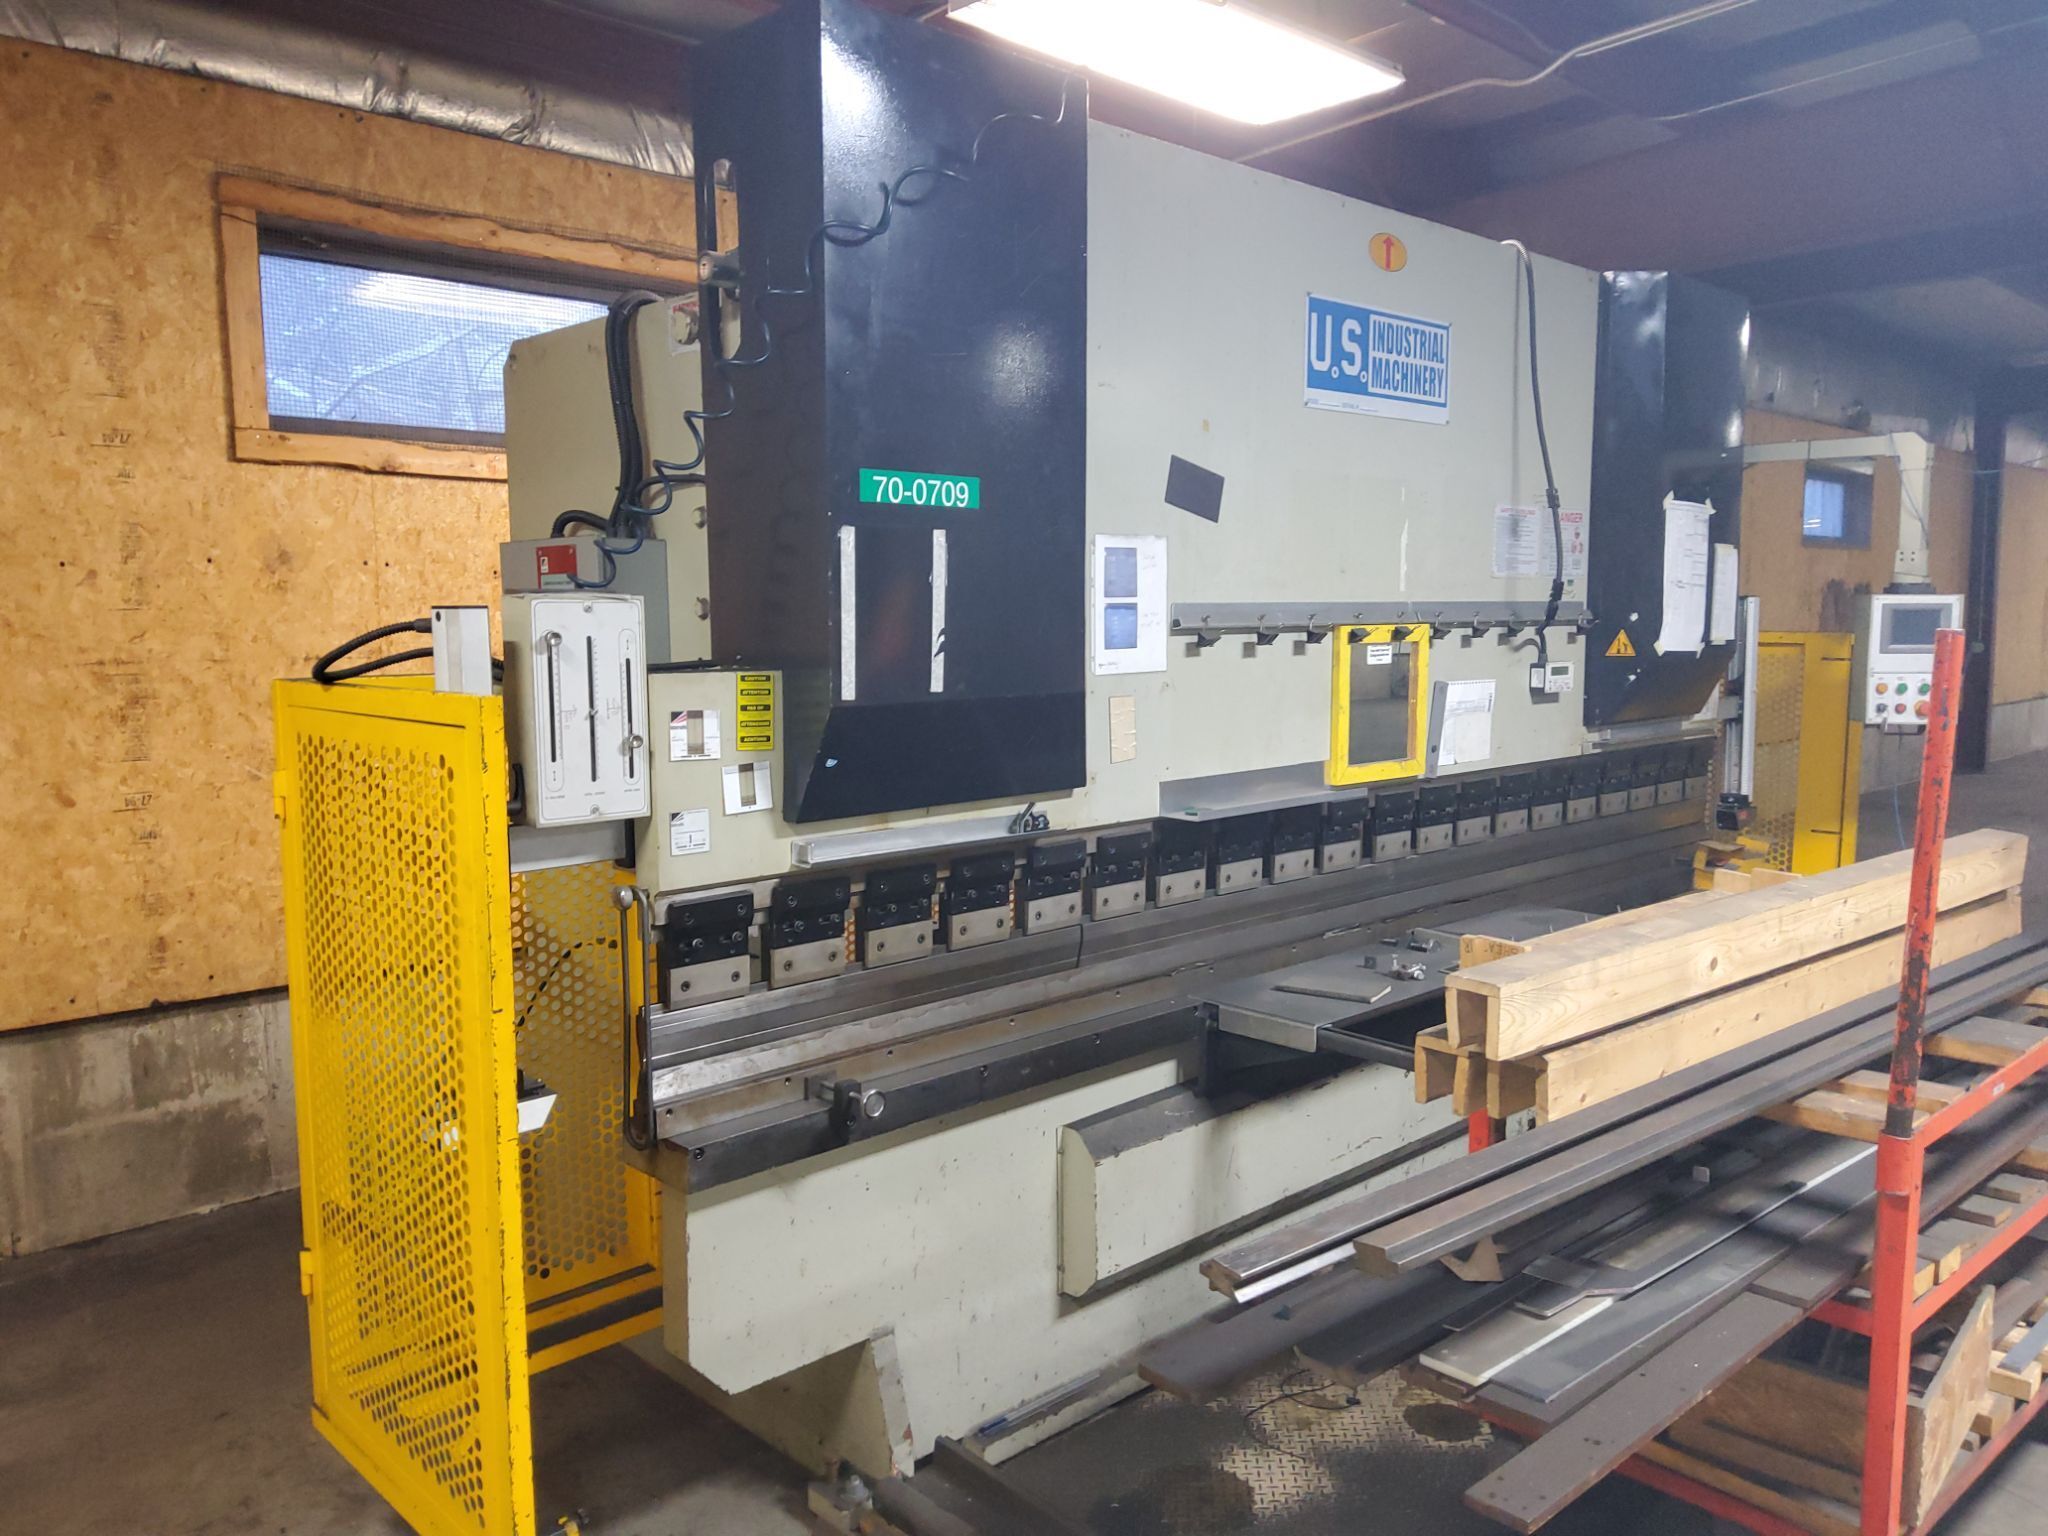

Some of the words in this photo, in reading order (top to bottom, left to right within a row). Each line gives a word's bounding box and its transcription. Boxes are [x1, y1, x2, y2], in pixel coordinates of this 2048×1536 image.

[1310, 312, 1367, 383] U.S.
[1371, 320, 1445, 365] INDUSTRIAL
[1371, 356, 1445, 399] MACHINERY
[872, 475, 969, 508] 70-0709
